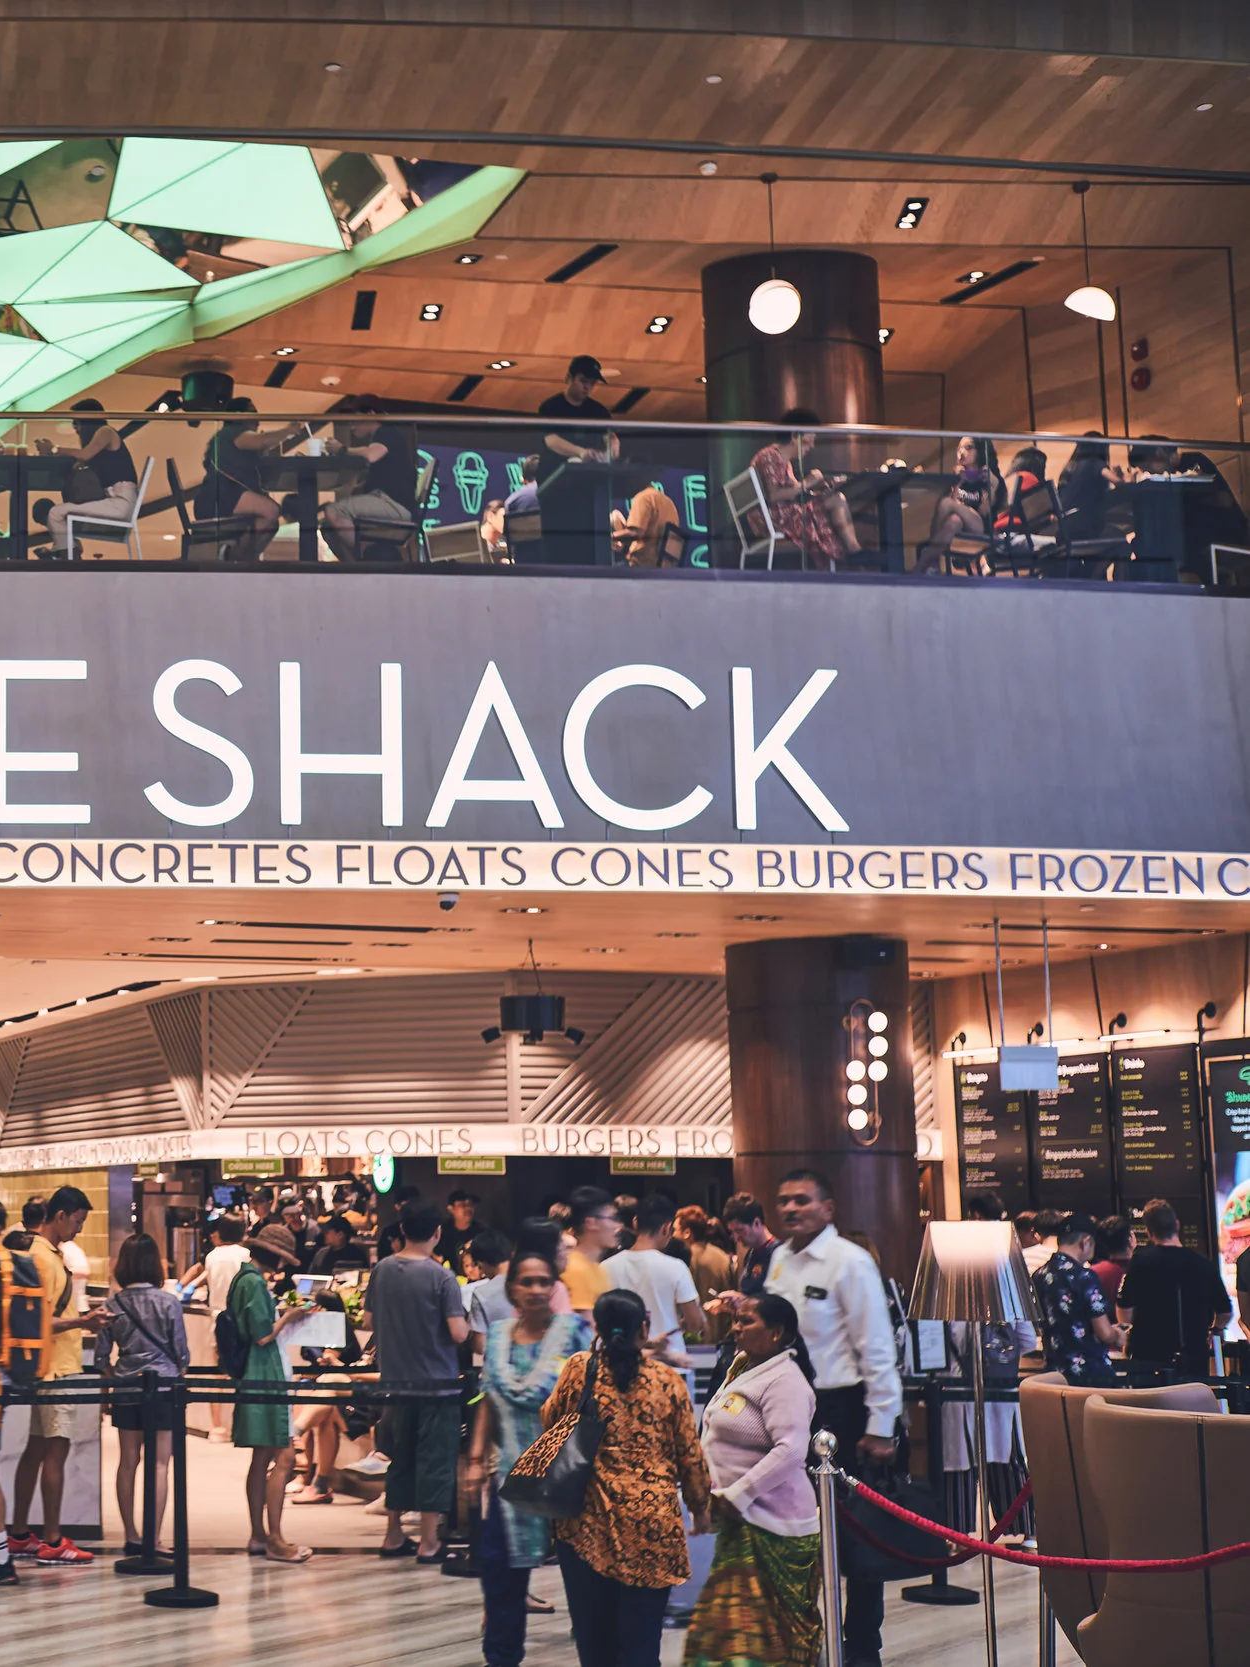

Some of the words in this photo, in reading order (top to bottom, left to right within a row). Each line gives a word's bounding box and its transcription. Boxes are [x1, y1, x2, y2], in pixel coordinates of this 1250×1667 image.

[143, 659, 850, 832] SHACK
[336, 844, 527, 886] FLOATS
[551, 847, 734, 888] CONES
[756, 850, 988, 891] BURGERS
[1009, 853, 1205, 895] FROZEN
[245, 1130, 351, 1156] FLOATS
[365, 1128, 473, 1155] CONES
[521, 1127, 661, 1156] BURGERS
